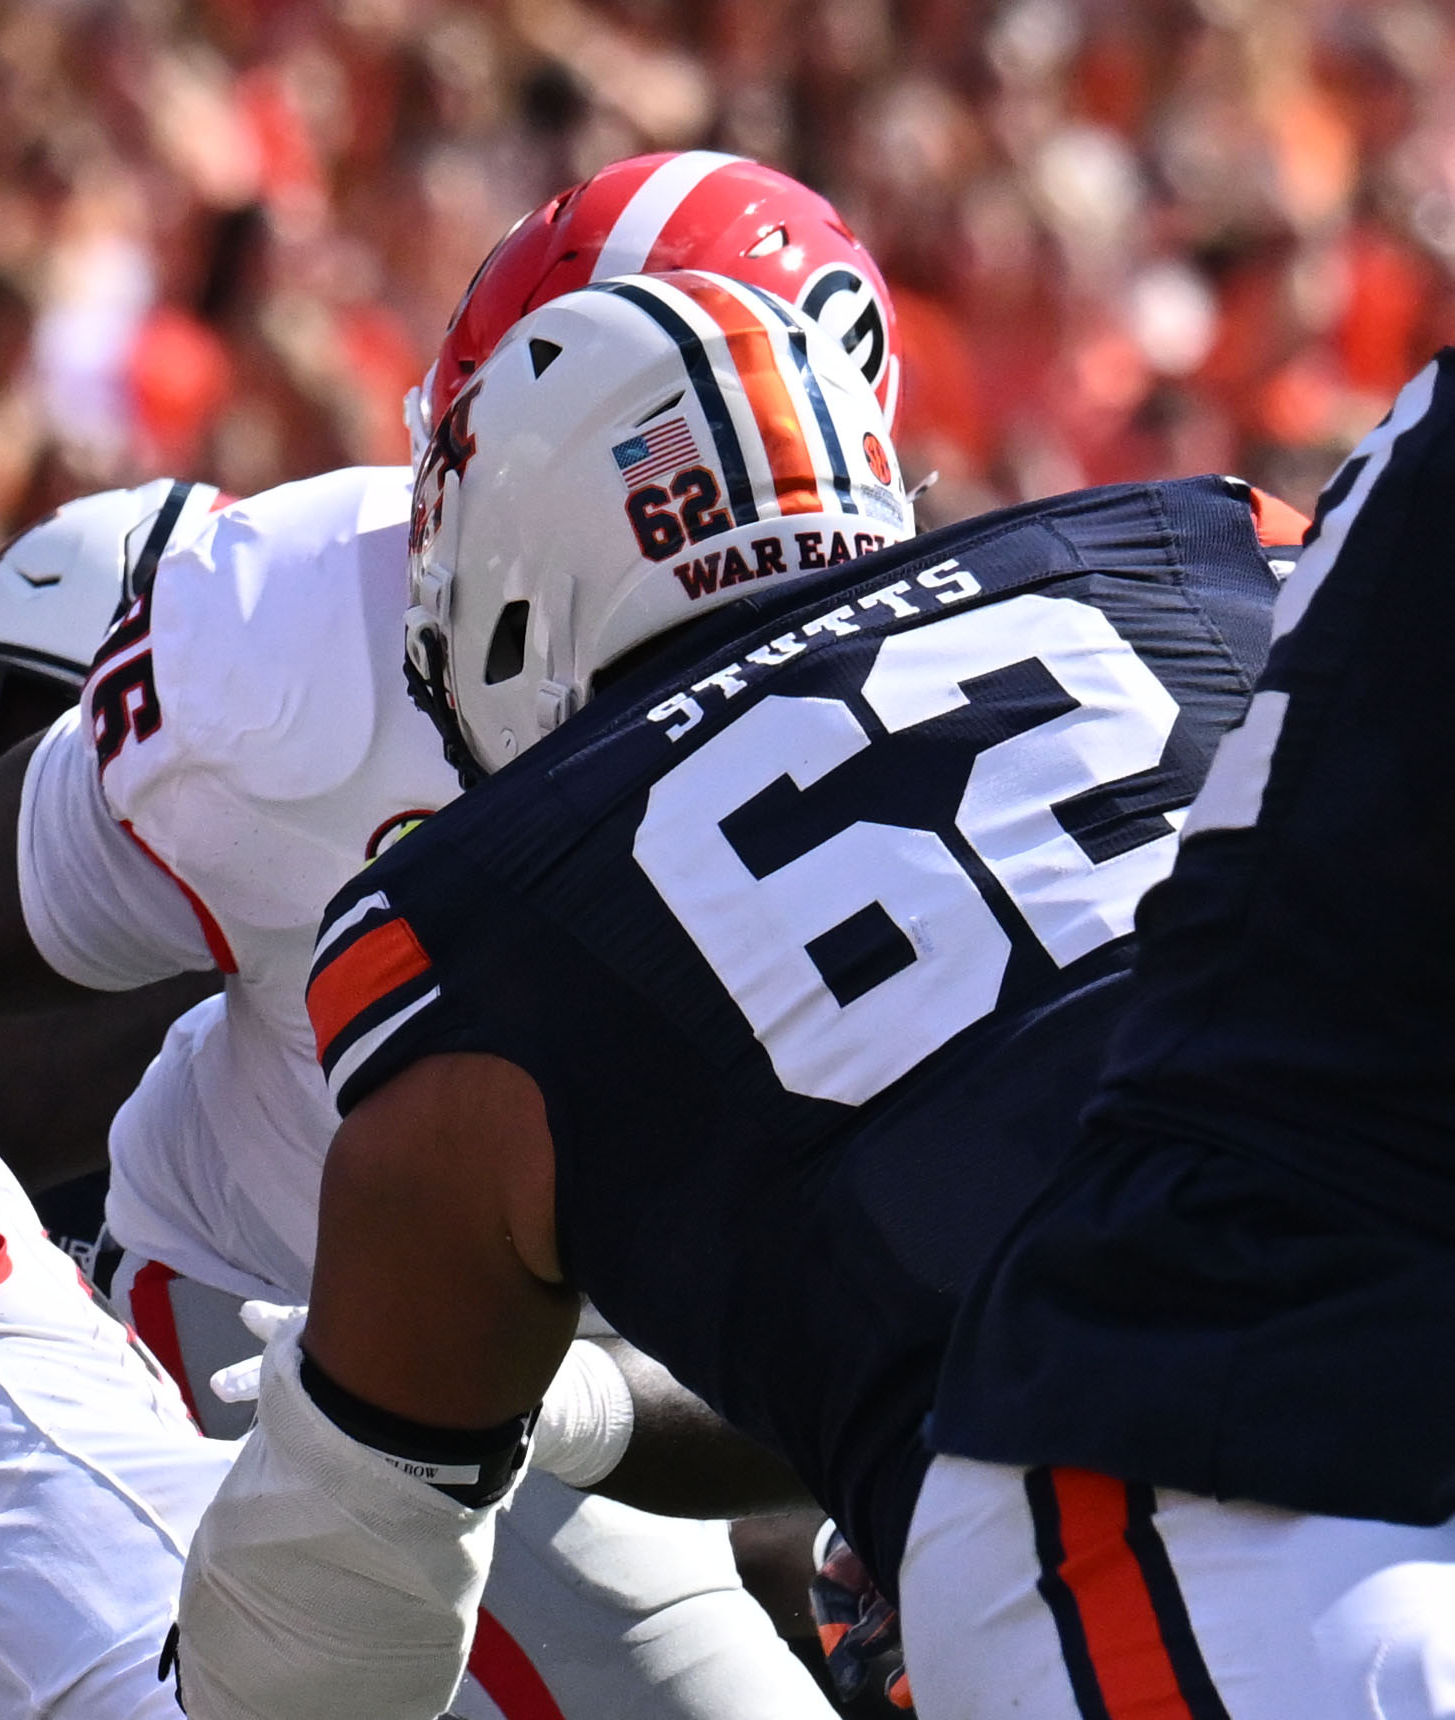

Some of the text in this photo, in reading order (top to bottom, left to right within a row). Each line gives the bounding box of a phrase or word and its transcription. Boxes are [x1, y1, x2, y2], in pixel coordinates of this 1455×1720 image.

[625, 464, 738, 563] 62
[673, 530, 902, 601] WAR EAGL
[646, 558, 983, 743] STUTTS
[632, 594, 1191, 1107] 62
